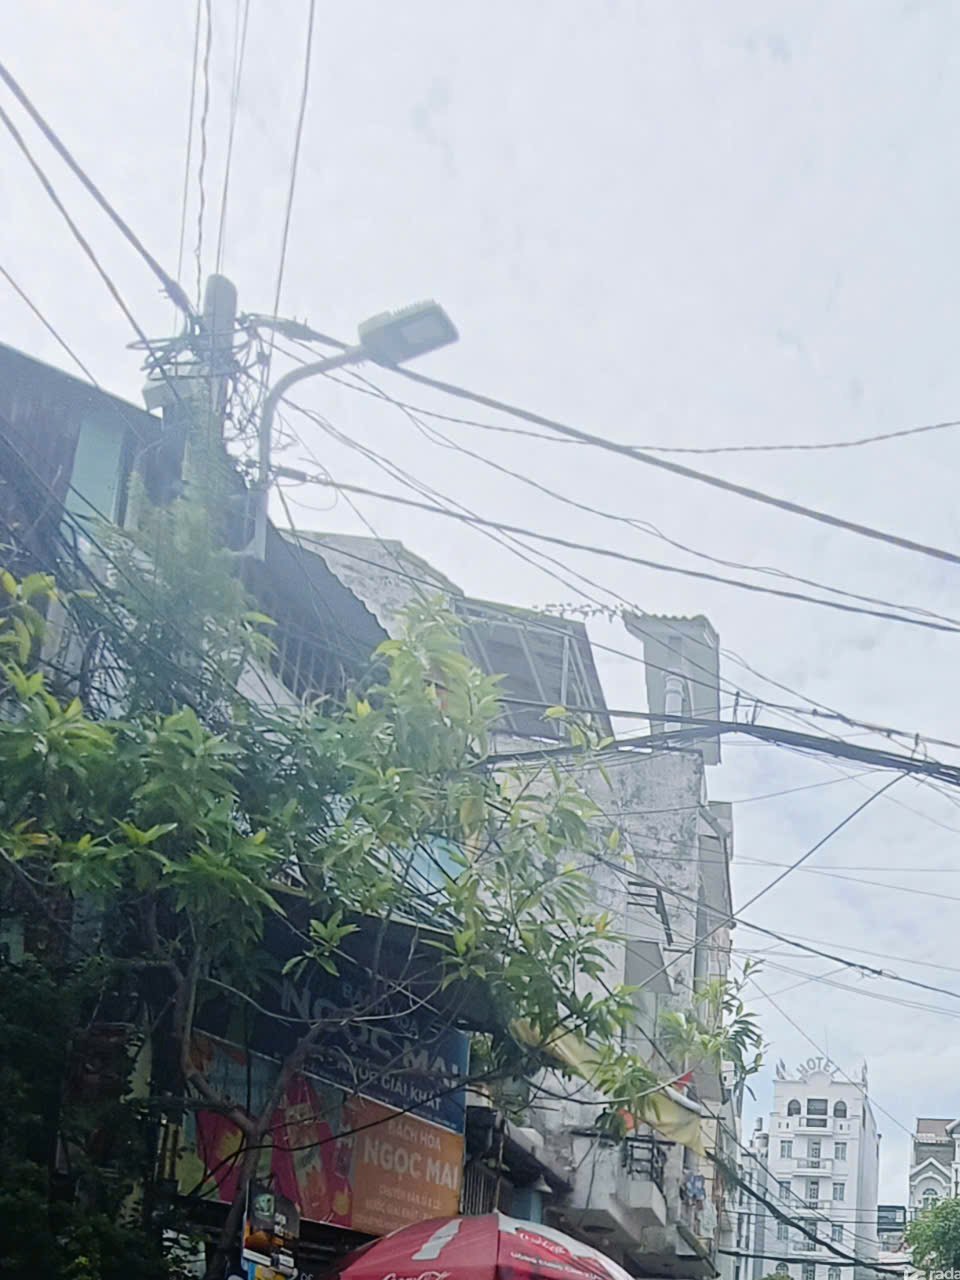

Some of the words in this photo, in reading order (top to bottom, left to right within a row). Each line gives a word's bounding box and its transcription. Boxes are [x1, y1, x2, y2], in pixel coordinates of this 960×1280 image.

[796, 1056, 840, 1080] HOTEL
[363, 1136, 422, 1181] NGỌC
[426, 1155, 459, 1191] MAI
